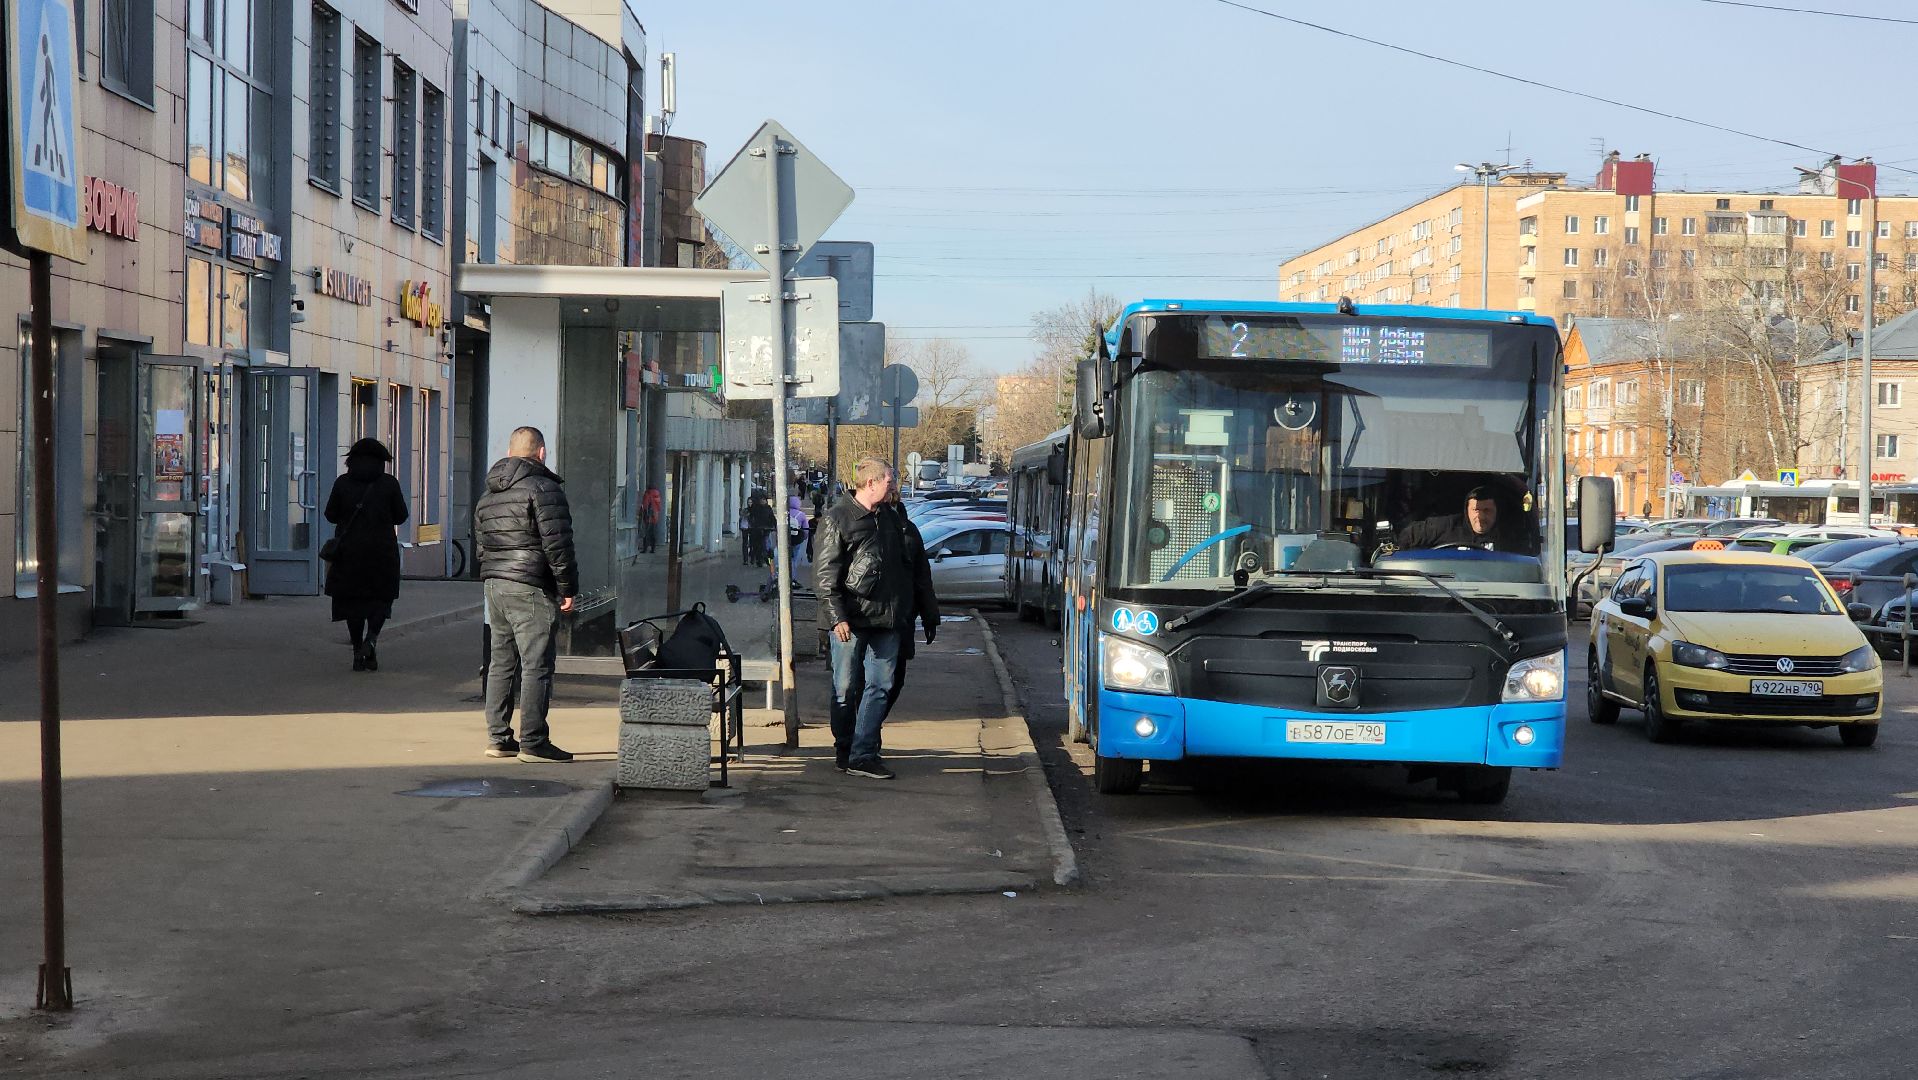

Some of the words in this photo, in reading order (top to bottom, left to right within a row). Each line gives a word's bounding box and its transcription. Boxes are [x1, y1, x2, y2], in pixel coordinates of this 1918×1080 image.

[1231, 322, 1248, 357] 2
[1801, 682, 1819, 692] 790
[1357, 725, 1381, 737] 790
